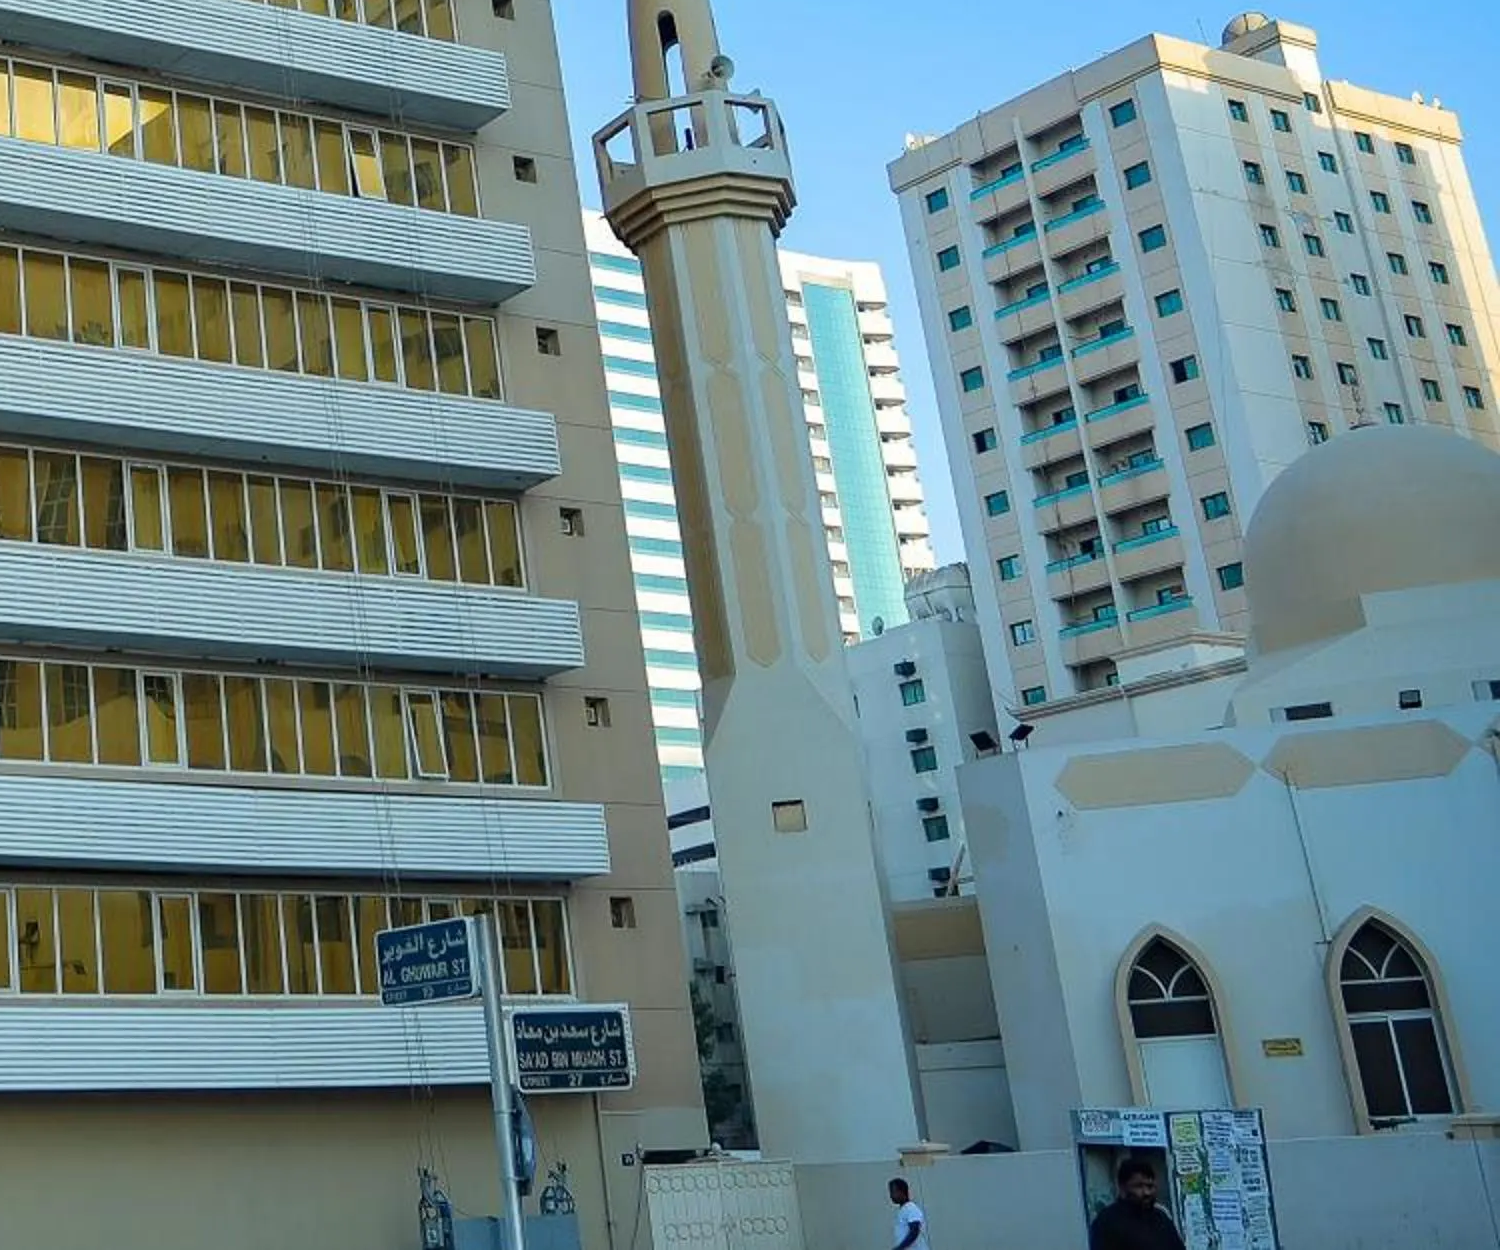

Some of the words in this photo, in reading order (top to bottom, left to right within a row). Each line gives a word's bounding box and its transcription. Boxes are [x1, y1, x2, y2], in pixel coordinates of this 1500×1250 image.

[427, 929, 466, 959] شارع
[383, 964, 397, 986] AL
[543, 1025, 559, 1045] بن
[560, 1024, 589, 1039] سعد
[591, 1018, 621, 1047] شارع
[551, 1051, 569, 1068] BIN
[568, 1072, 583, 1087] 27
